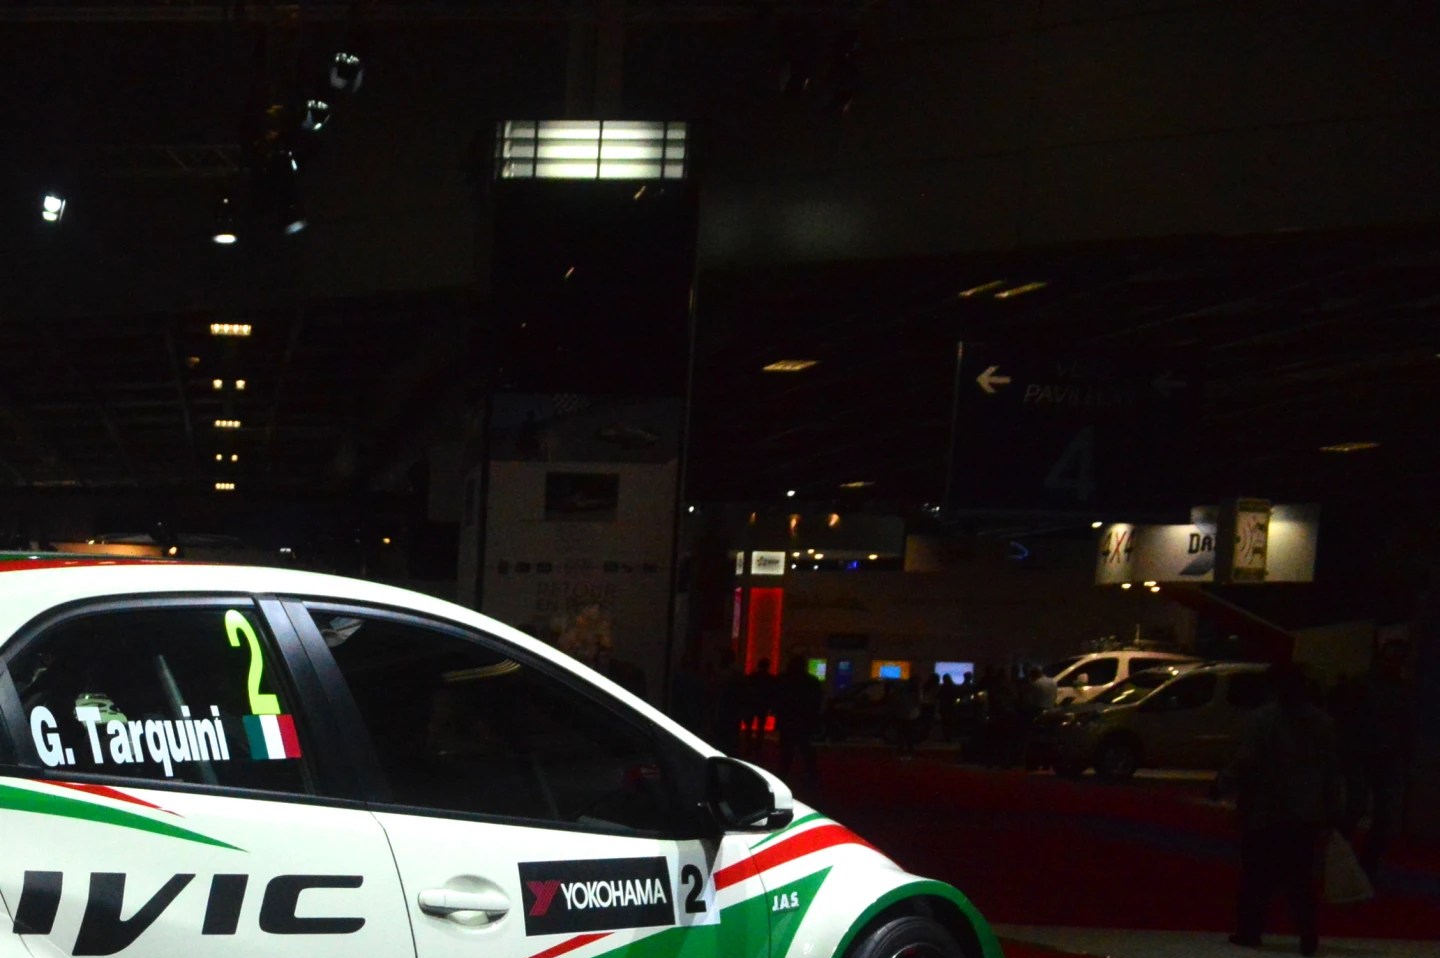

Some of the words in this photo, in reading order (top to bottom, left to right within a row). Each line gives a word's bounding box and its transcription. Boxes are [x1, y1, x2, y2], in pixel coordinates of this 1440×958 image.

[224, 609, 281, 715] 2
[30, 705, 76, 767] G.
[76, 705, 230, 777] Tarquini
[560, 877, 667, 910] YOKOHAMA
[681, 864, 707, 914] 2
